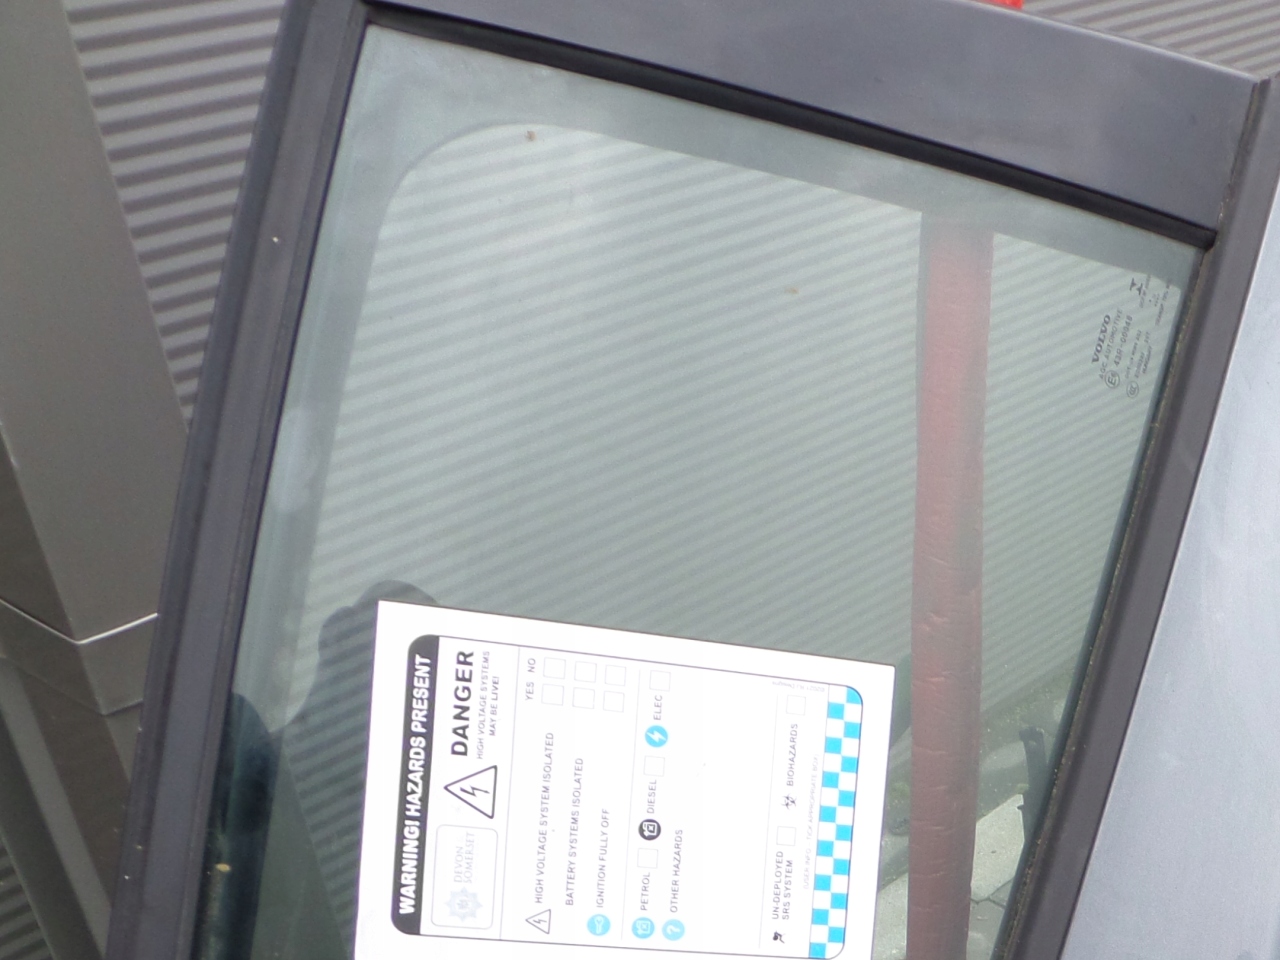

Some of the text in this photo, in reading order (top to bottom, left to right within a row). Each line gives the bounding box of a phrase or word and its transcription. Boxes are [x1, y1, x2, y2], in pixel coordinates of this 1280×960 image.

[1091, 314, 1111, 364] VOLVO
[1099, 309, 1123, 379] AGC AUTOMOTIVE
[451, 651, 474, 757] DANGER
[476, 651, 490, 760] HIGH VOLTAGE SYSTEMS
[489, 676, 500, 736] MAY BE LIVE!
[525, 658, 536, 701] YES NO
[653, 695, 663, 720] ELEC
[399, 654, 431, 915] WARNING! HAZARDS PRESENT
[786, 723, 798, 787] BIOHAZARDS
[534, 732, 554, 904] HIGH VOLTAGE SYSTEM ISOLATED
[647, 780, 657, 814] DIESEL
[463, 831, 476, 885] SOMERSET
[565, 758, 584, 906] BATTERY SYSTEMS ISOLATED
[596, 809, 610, 908] IGNITION FULLY OFF
[453, 846, 465, 883] DEVON
[640, 872, 651, 911] PETROL
[670, 829, 683, 913] OTHER HAZARDS
[772, 851, 783, 920] UN-DEPLOYED
[782, 860, 793, 920] SRS SYSTEM
